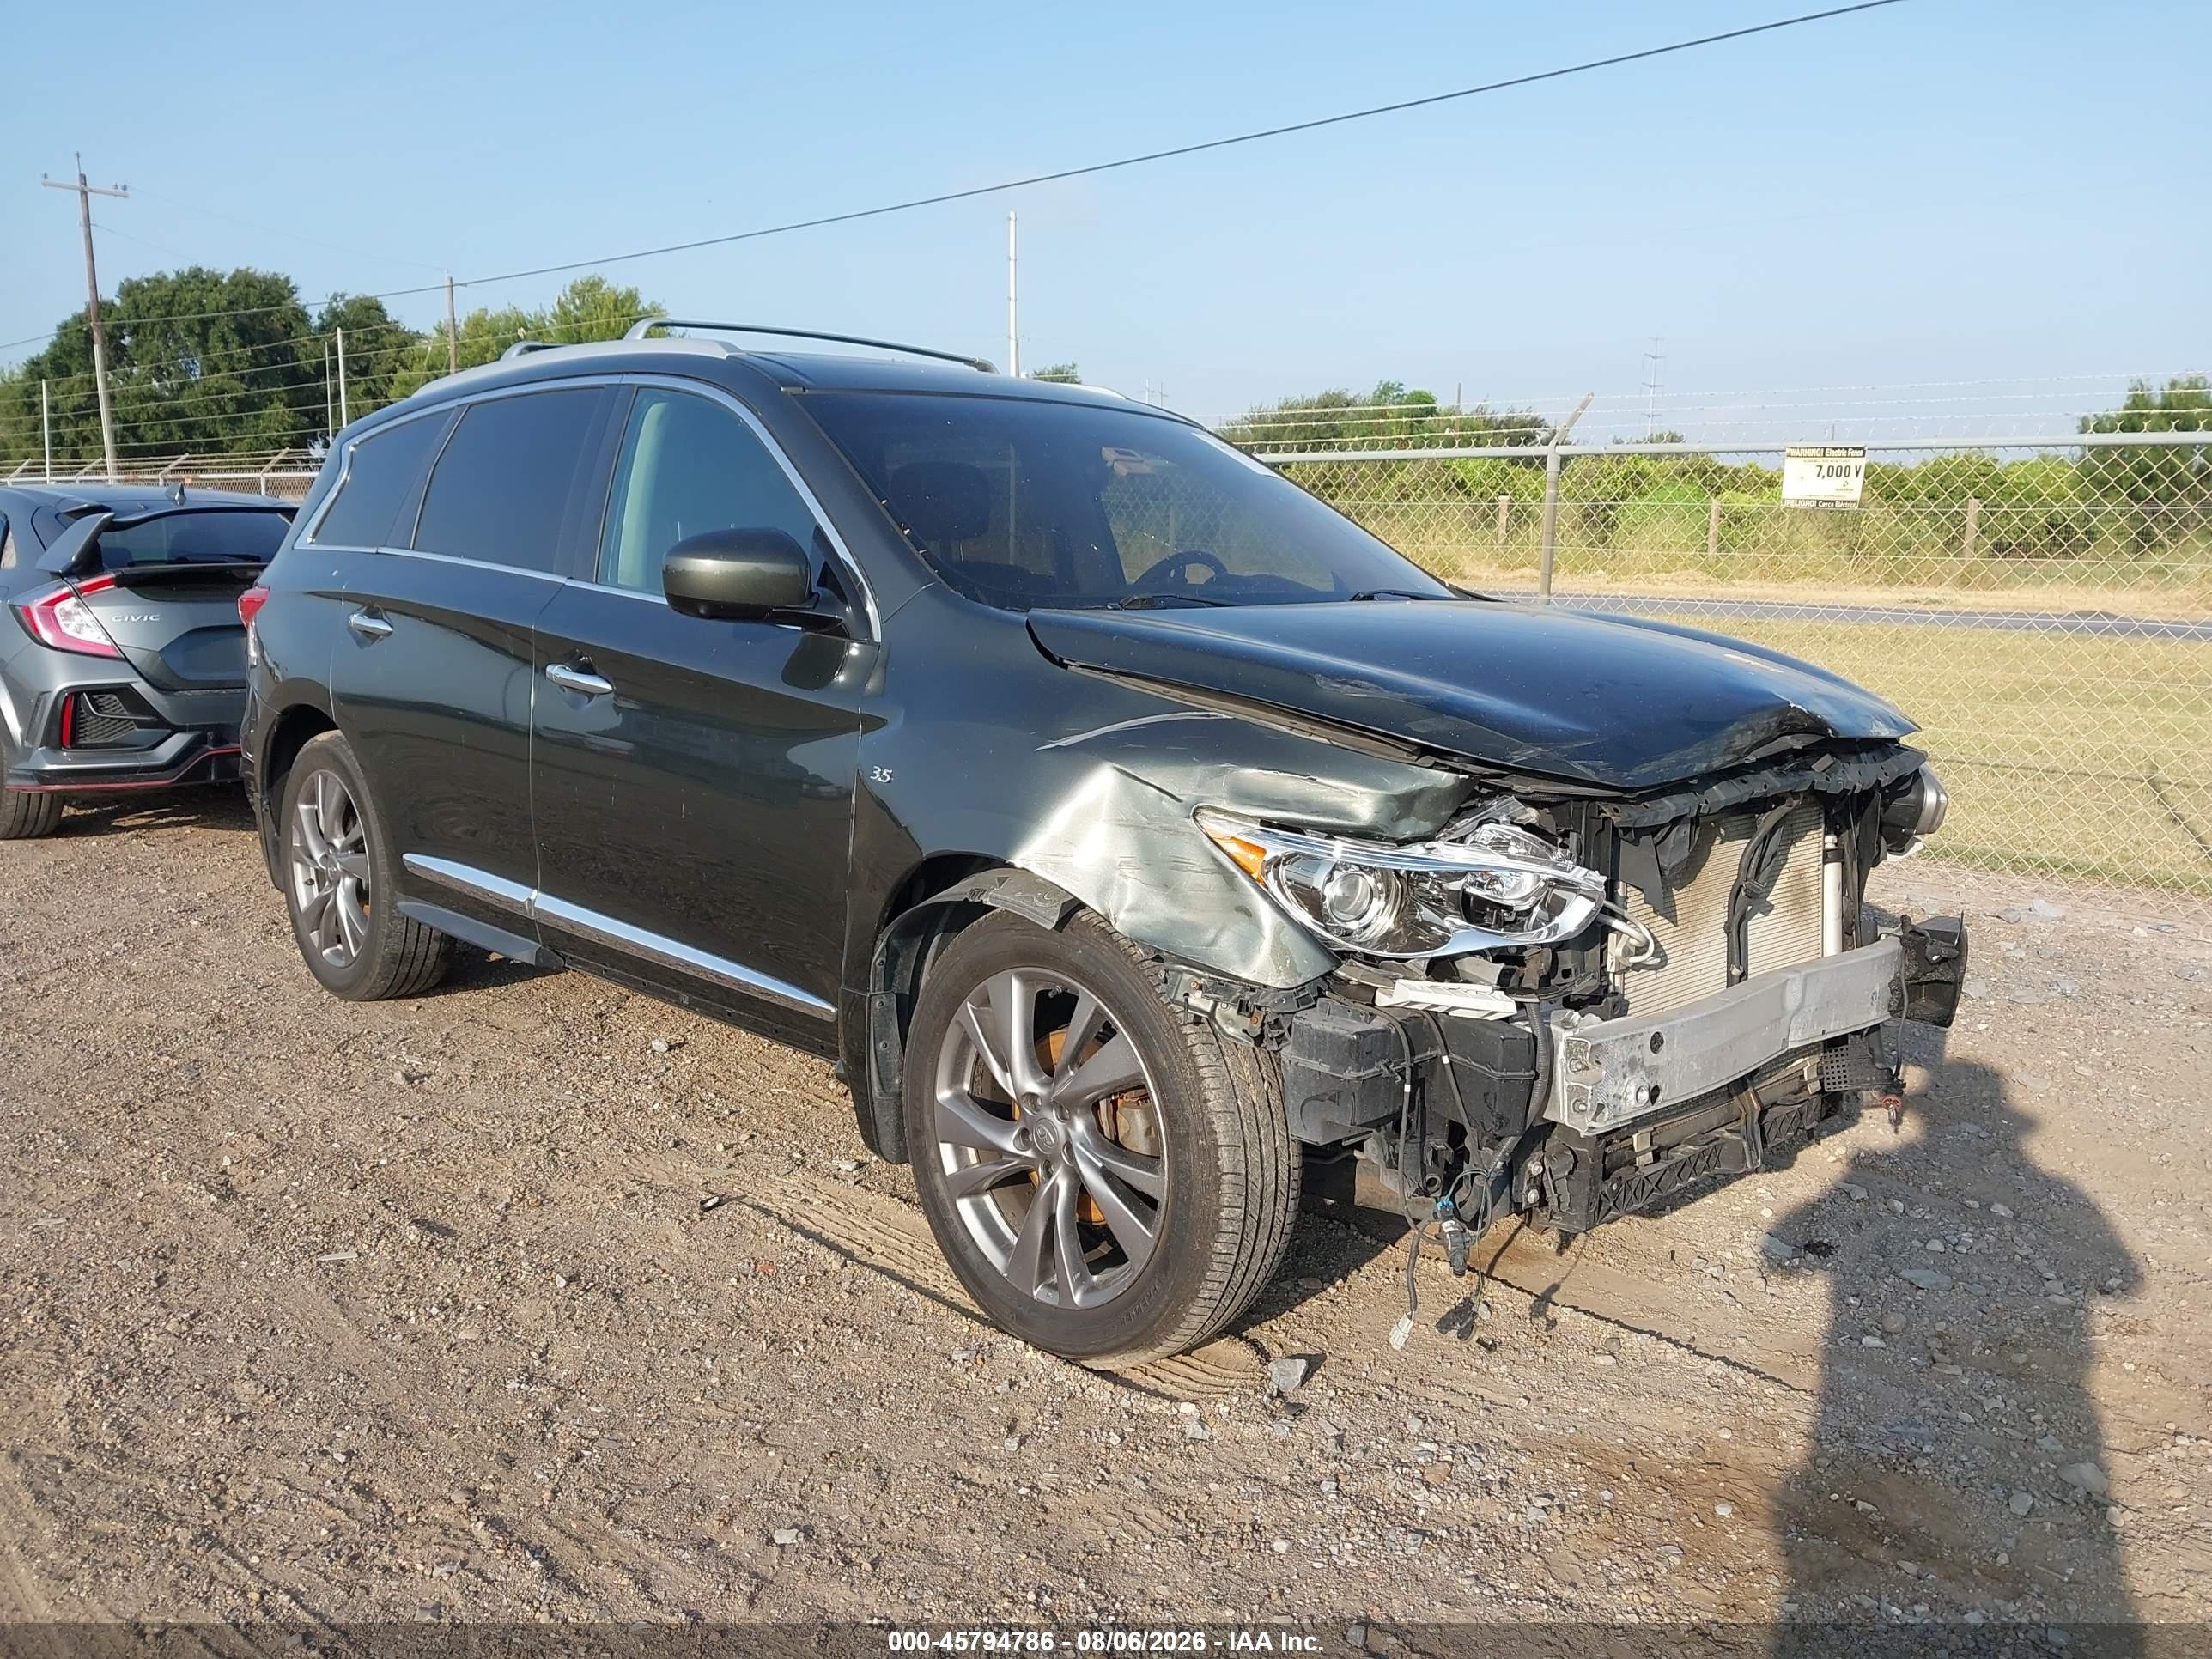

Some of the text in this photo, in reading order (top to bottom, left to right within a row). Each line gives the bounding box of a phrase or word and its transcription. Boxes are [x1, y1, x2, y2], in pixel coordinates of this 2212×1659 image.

[1826, 448, 1847, 457] Electric
[1848, 448, 1863, 457] Fence
[1816, 465, 1862, 479] 7,000 V
